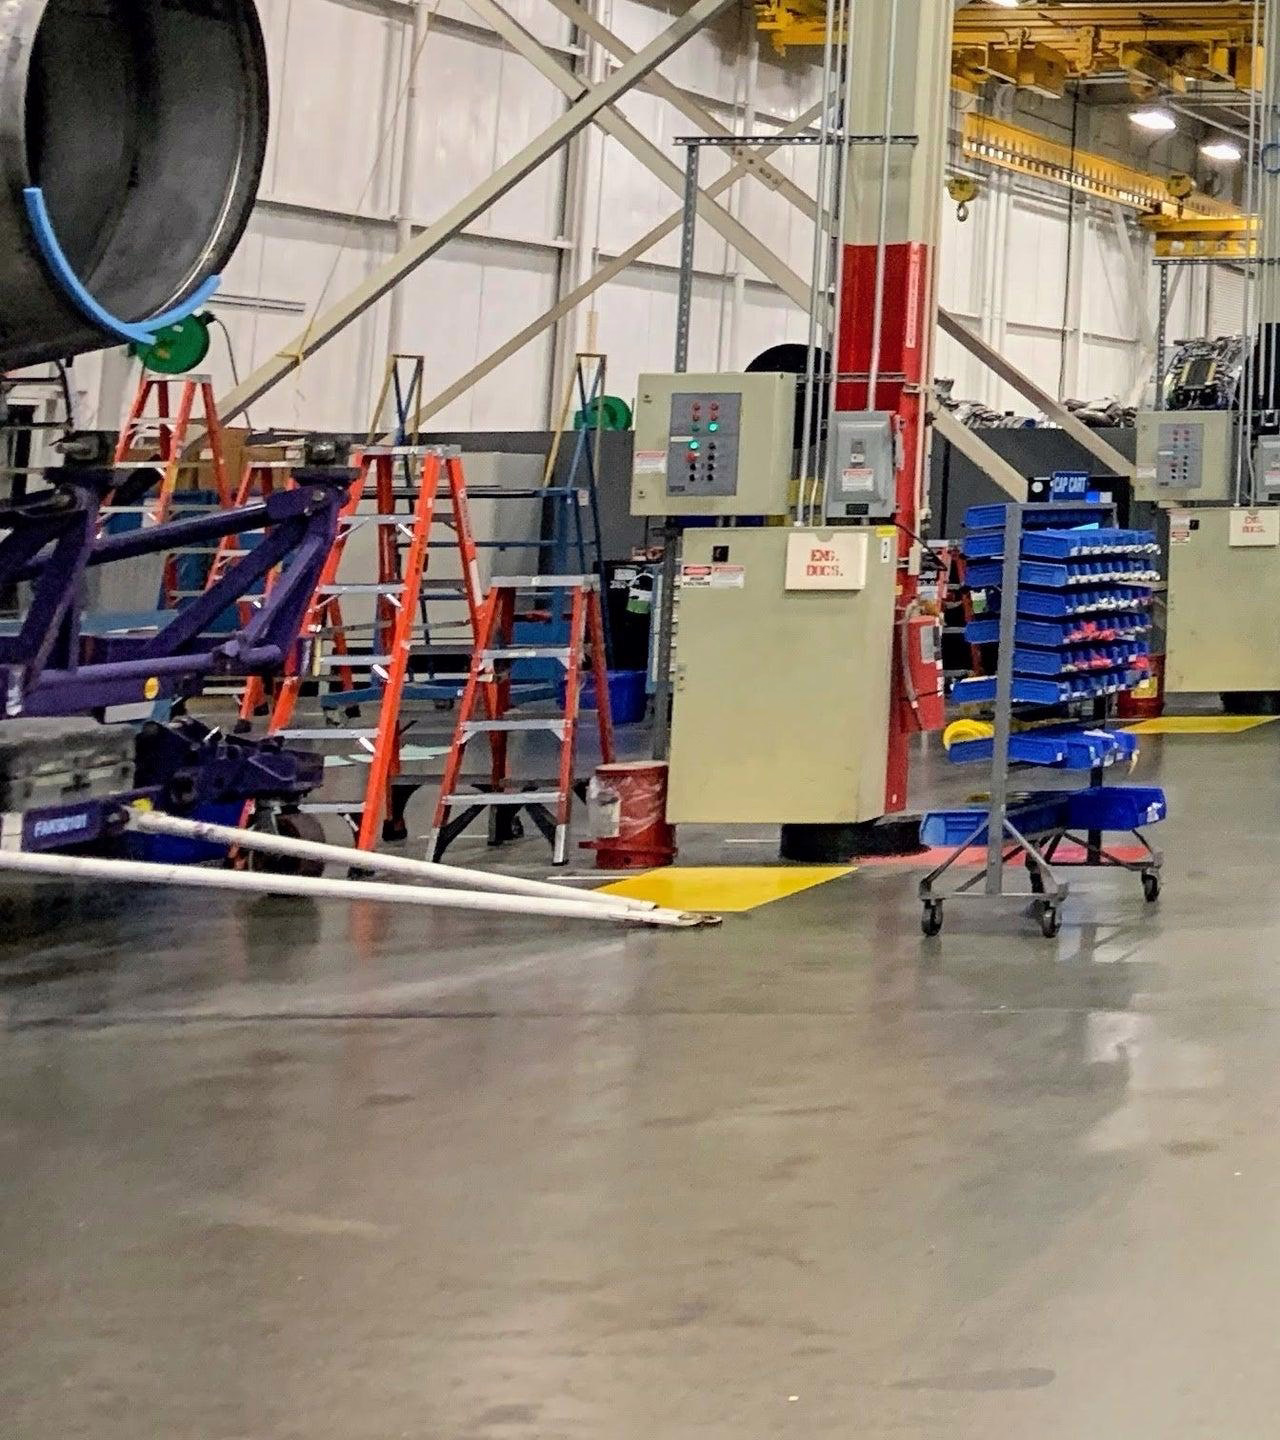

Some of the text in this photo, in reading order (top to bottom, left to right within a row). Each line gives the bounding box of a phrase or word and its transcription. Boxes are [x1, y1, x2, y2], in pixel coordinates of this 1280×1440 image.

[1054, 476, 1087, 493] CAP CART
[810, 549, 840, 561] ENG.
[806, 565, 844, 576] DOCS.
